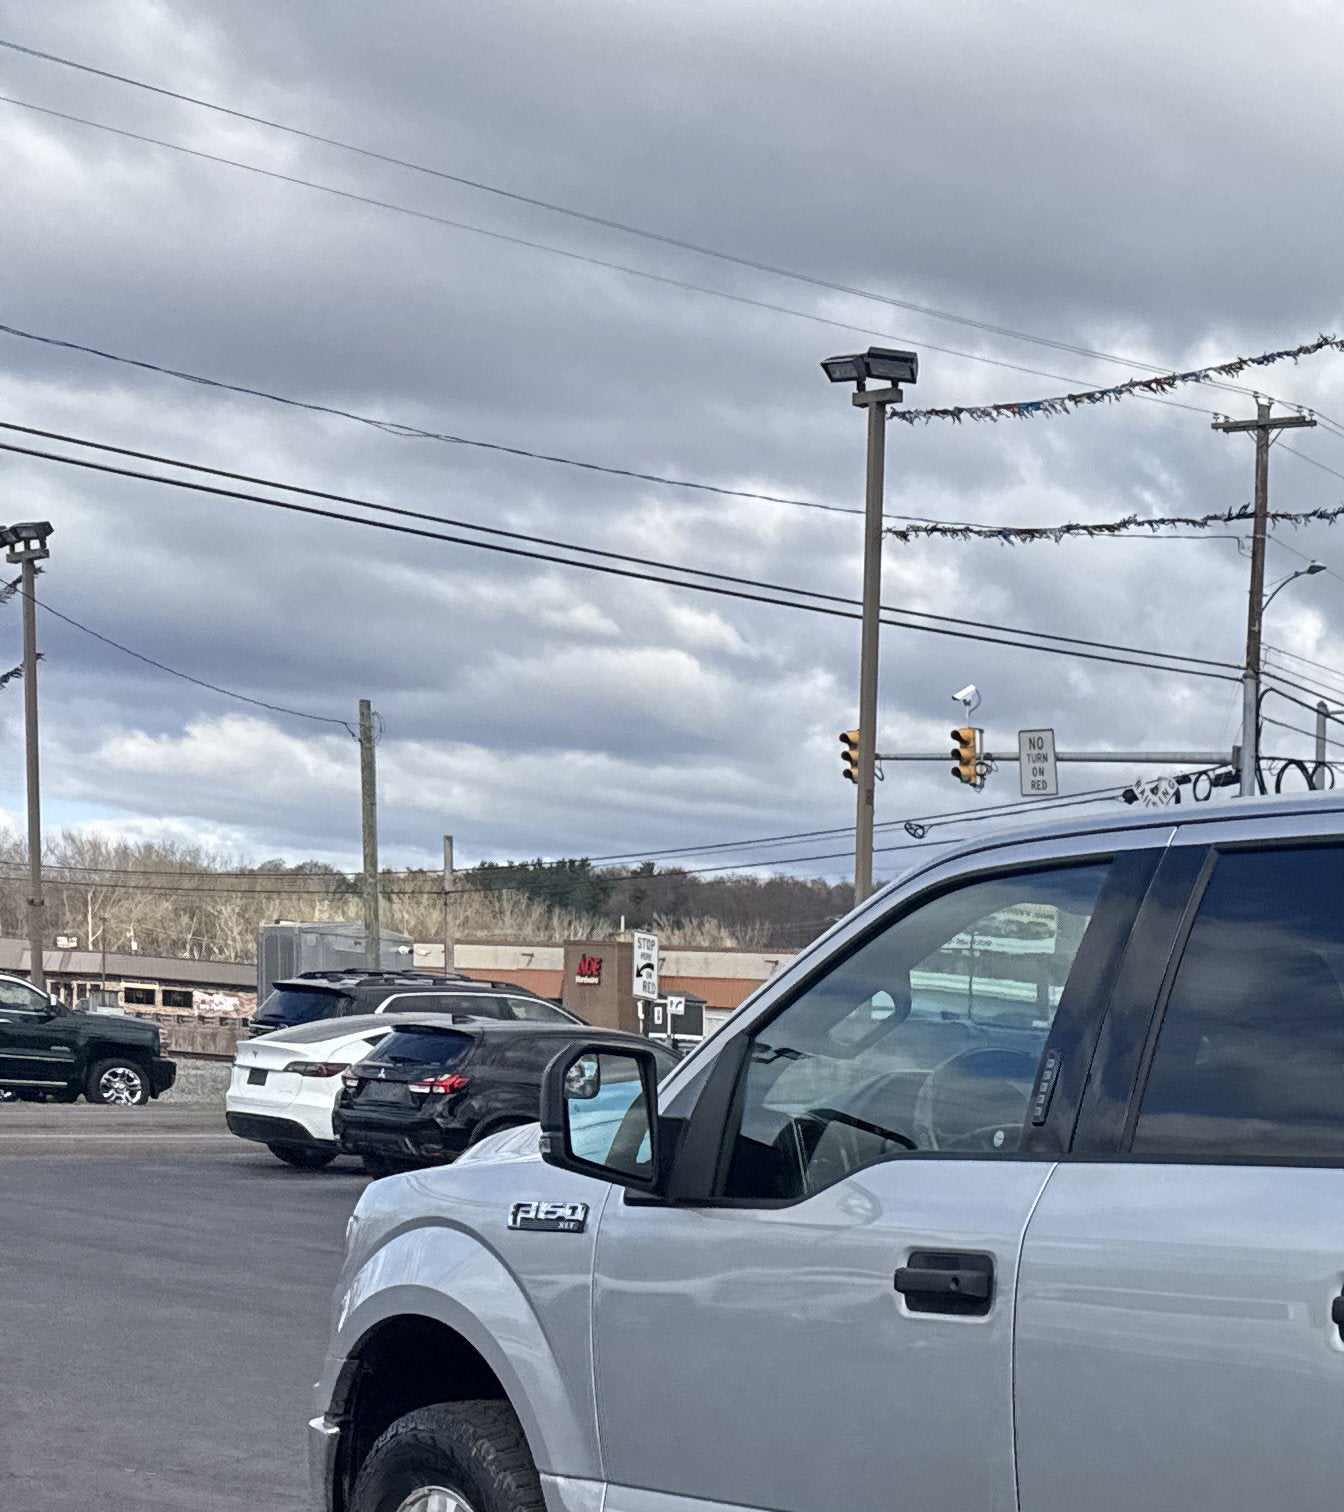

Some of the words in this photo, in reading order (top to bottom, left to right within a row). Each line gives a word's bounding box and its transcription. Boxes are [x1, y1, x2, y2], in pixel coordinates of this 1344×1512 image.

[1028, 736, 1044, 750] NO
[1026, 753, 1048, 764] TURN
[1031, 767, 1045, 777] ON
[1030, 780, 1048, 791] RED
[637, 936, 656, 951] STOP
[576, 955, 602, 976] ACE
[642, 981, 656, 995] RED
